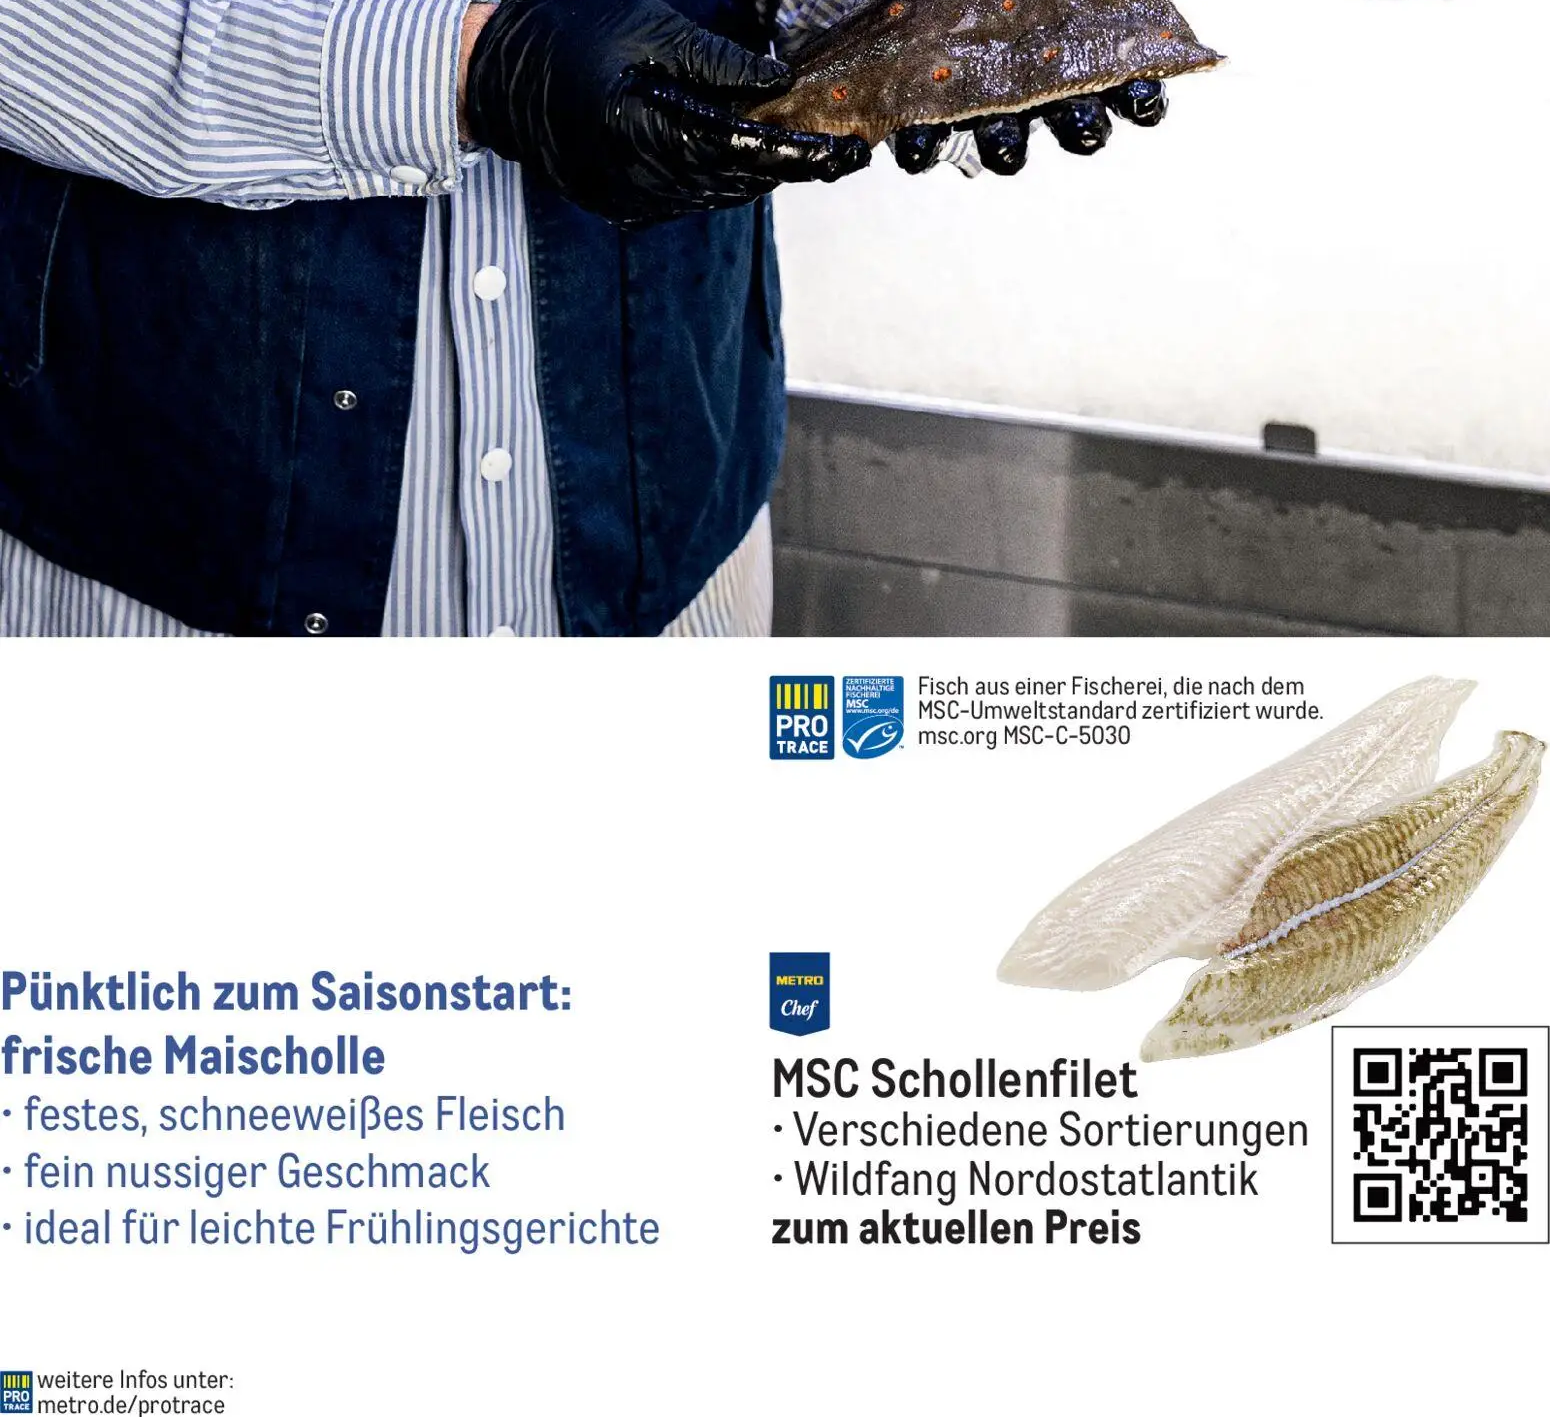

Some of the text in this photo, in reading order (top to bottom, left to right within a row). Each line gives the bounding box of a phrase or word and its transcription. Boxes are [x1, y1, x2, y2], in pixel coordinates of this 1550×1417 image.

[846, 699, 869, 709] MSC
[776, 715, 829, 738] PRO
[776, 740, 829, 754] TRACE
[776, 976, 824, 985] METRO
[781, 999, 819, 1021] Chef
[3, 1391, 30, 1402] PRO
[3, 1403, 30, 1411] TRACE
